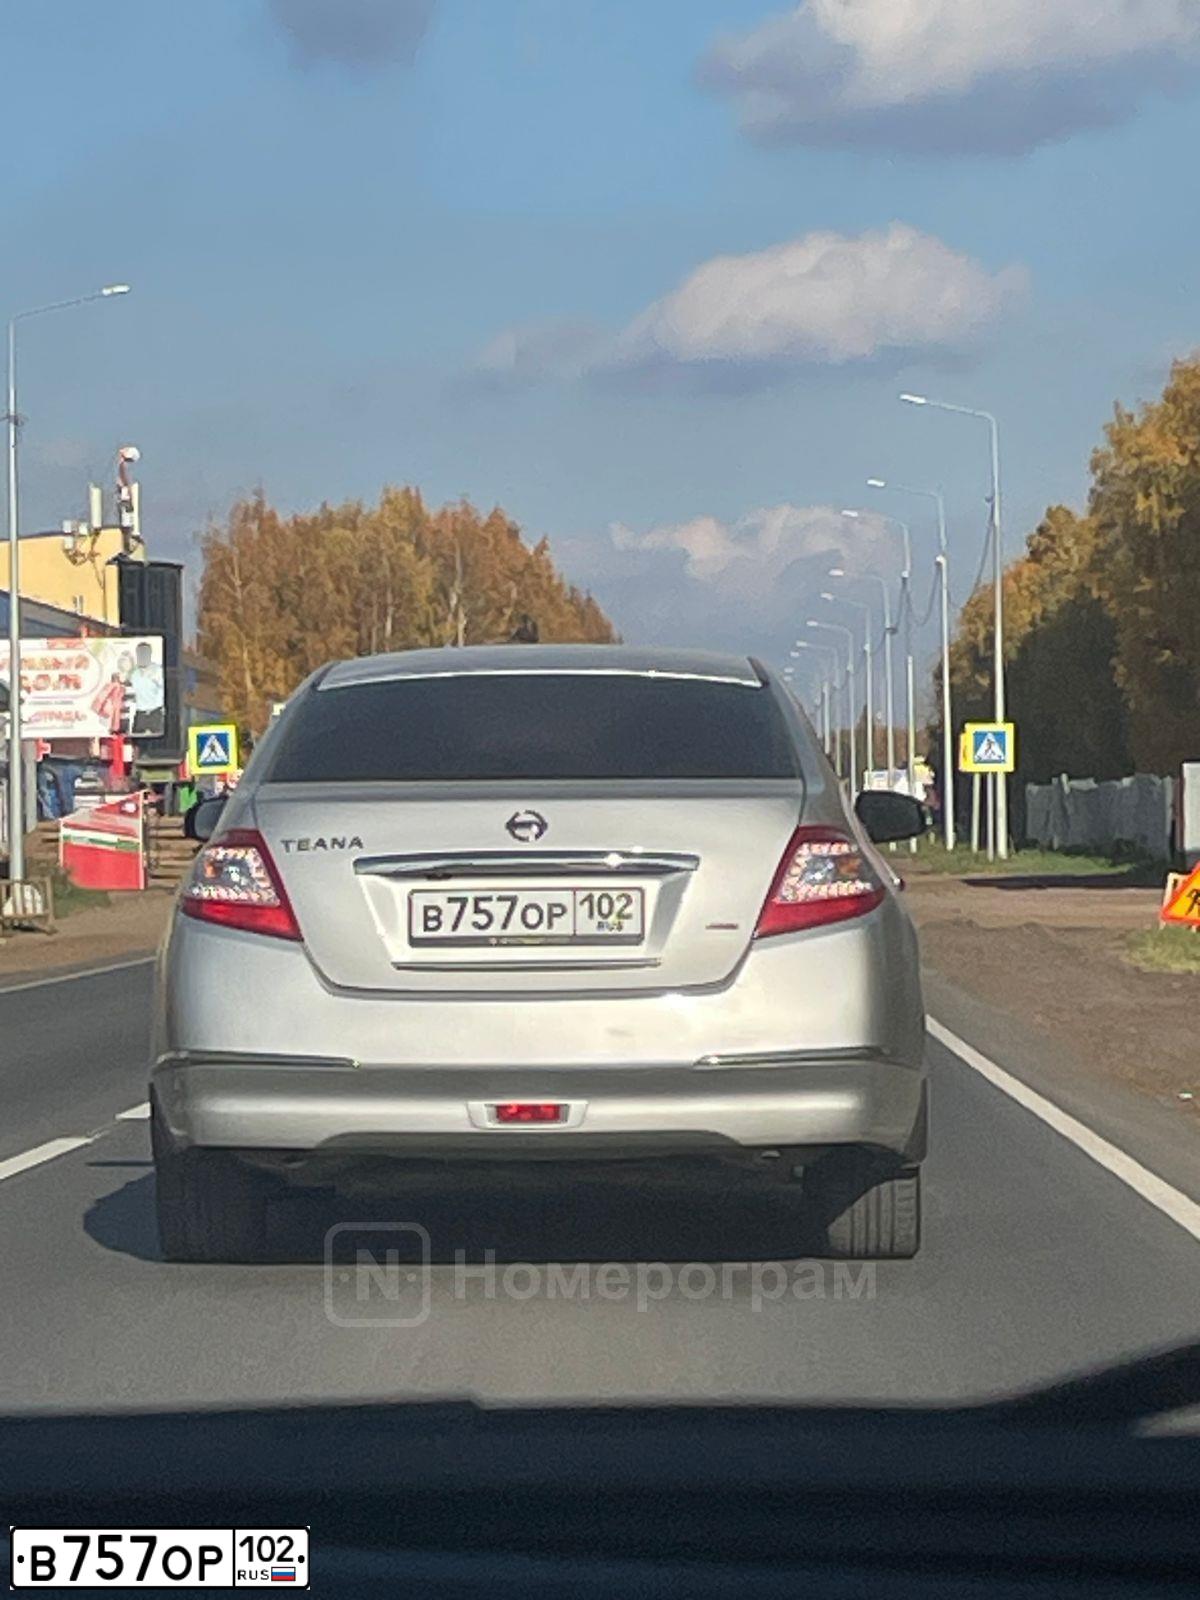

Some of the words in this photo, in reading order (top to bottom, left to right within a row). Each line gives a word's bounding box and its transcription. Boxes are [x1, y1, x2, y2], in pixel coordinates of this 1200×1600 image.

[280, 836, 363, 853] TEANA
[423, 895, 567, 932] В757ОР
[579, 893, 633, 920] 102
